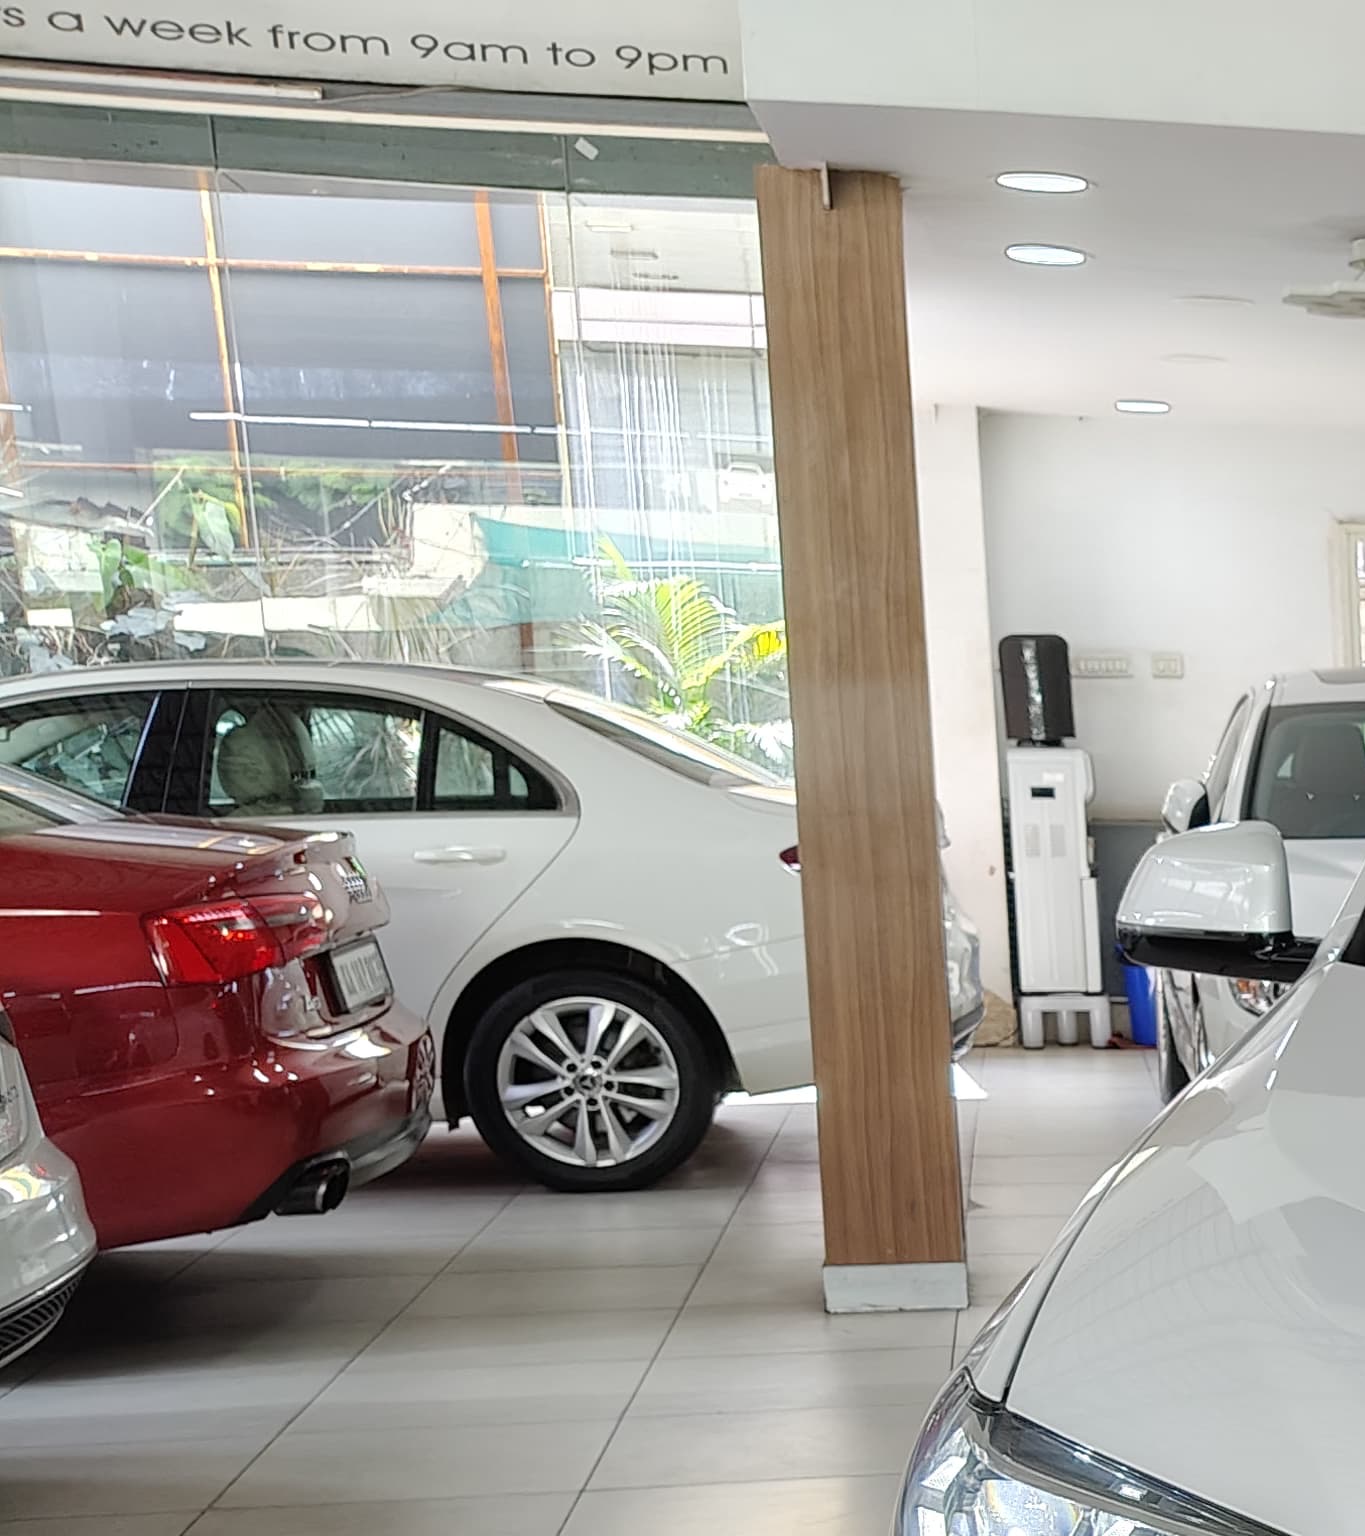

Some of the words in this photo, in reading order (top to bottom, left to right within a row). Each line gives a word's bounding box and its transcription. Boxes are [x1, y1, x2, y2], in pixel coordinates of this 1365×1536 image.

[0, 6, 26, 28] s
[47, 10, 85, 33] a
[104, 15, 253, 48] week
[267, 24, 391, 56] from
[410, 33, 529, 65] 9am
[546, 42, 597, 67] to
[614, 45, 729, 76] 9pm
